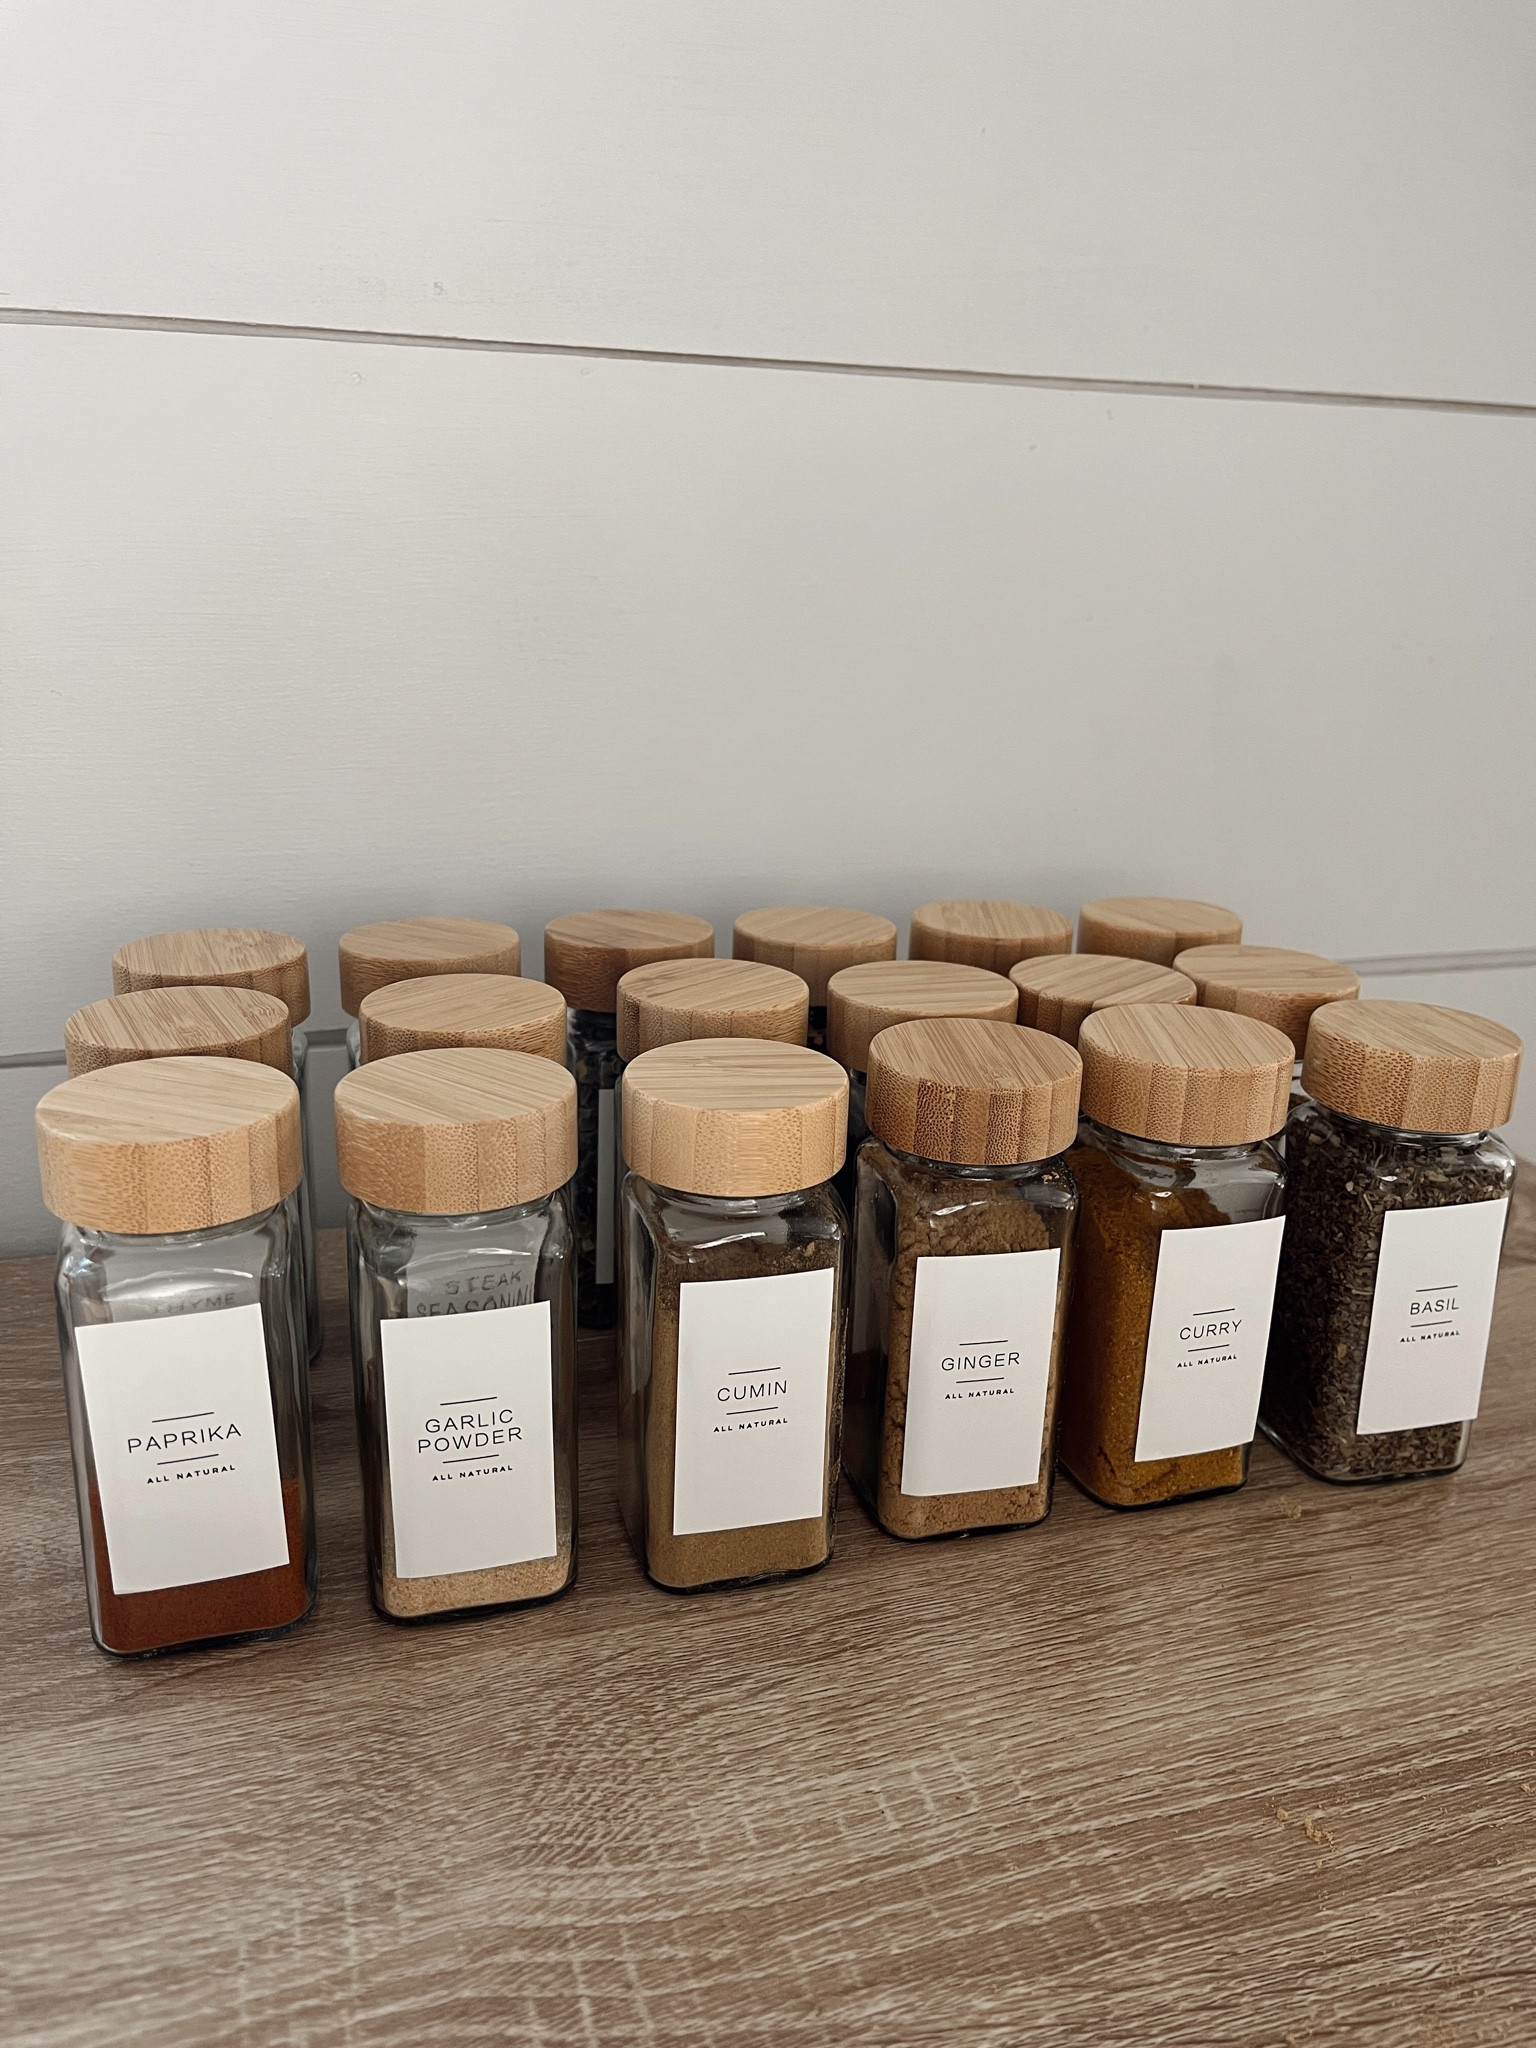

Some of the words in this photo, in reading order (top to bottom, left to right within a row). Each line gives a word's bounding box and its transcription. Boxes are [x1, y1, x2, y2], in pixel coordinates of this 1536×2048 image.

[444, 1270, 522, 1295] STEAK
[416, 1282, 534, 1317] SEASONIN
[1409, 1297, 1460, 1316] BASIL
[1179, 1319, 1243, 1341] CURRY
[1420, 1330, 1460, 1341] NATURAL
[941, 1351, 1020, 1372] GINGER
[1176, 1360, 1194, 1369] ALL
[1197, 1353, 1238, 1366] NATURAL
[717, 1379, 788, 1402] CUMIN
[944, 1392, 963, 1400] ALL
[968, 1387, 1015, 1398] NATURAL
[424, 1408, 514, 1434] GARLIC
[713, 1425, 734, 1433] ALL
[738, 1417, 788, 1430] NATURAL
[127, 1423, 242, 1454] PAPRIKA
[417, 1426, 523, 1454] POWDER
[146, 1475, 170, 1485] ALL
[176, 1464, 236, 1480] NATURAL
[431, 1473, 454, 1482] ALL
[459, 1464, 513, 1479] NATURAL
